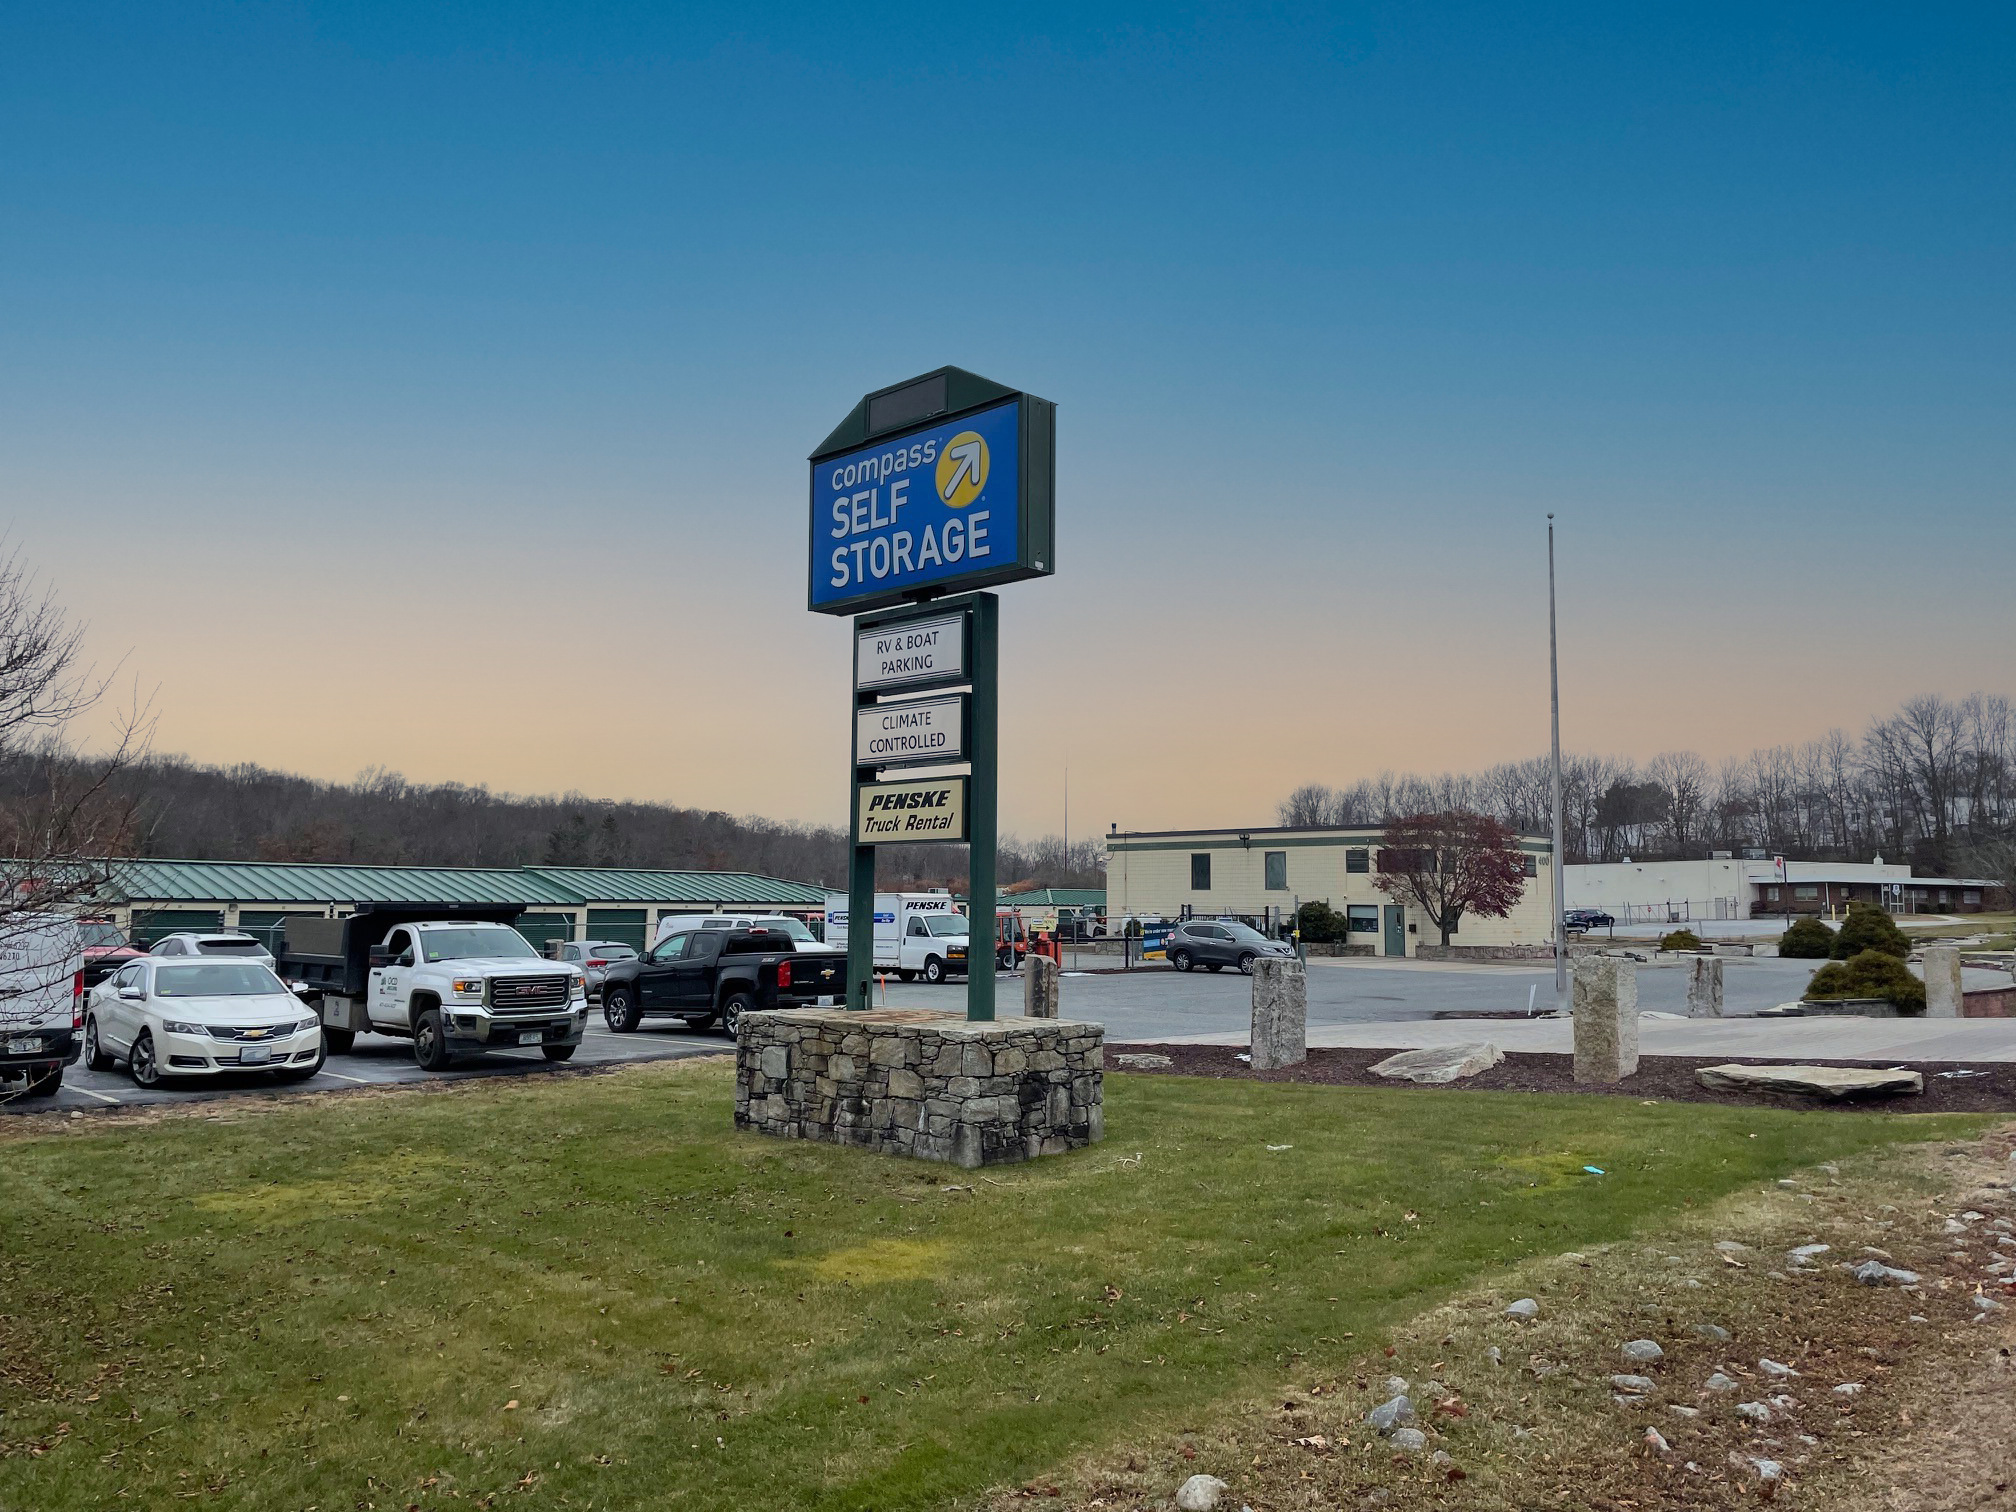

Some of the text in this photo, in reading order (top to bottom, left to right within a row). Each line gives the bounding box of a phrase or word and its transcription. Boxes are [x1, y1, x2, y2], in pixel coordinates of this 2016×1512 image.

[831, 439, 937, 491] compass
[830, 478, 910, 539] SELF
[830, 510, 991, 588] STORAGE
[877, 631, 939, 655] RV & BOAT
[881, 654, 933, 675] PARKING
[882, 711, 931, 730] CLIMATE
[869, 732, 946, 753] CONTROLLED
[868, 790, 951, 812] PENSKE
[864, 812, 954, 833] Truck Rental
[1538, 856, 1550, 866] 400
[905, 901, 947, 910] PENSKE
[515, 985, 548, 996] GMC
